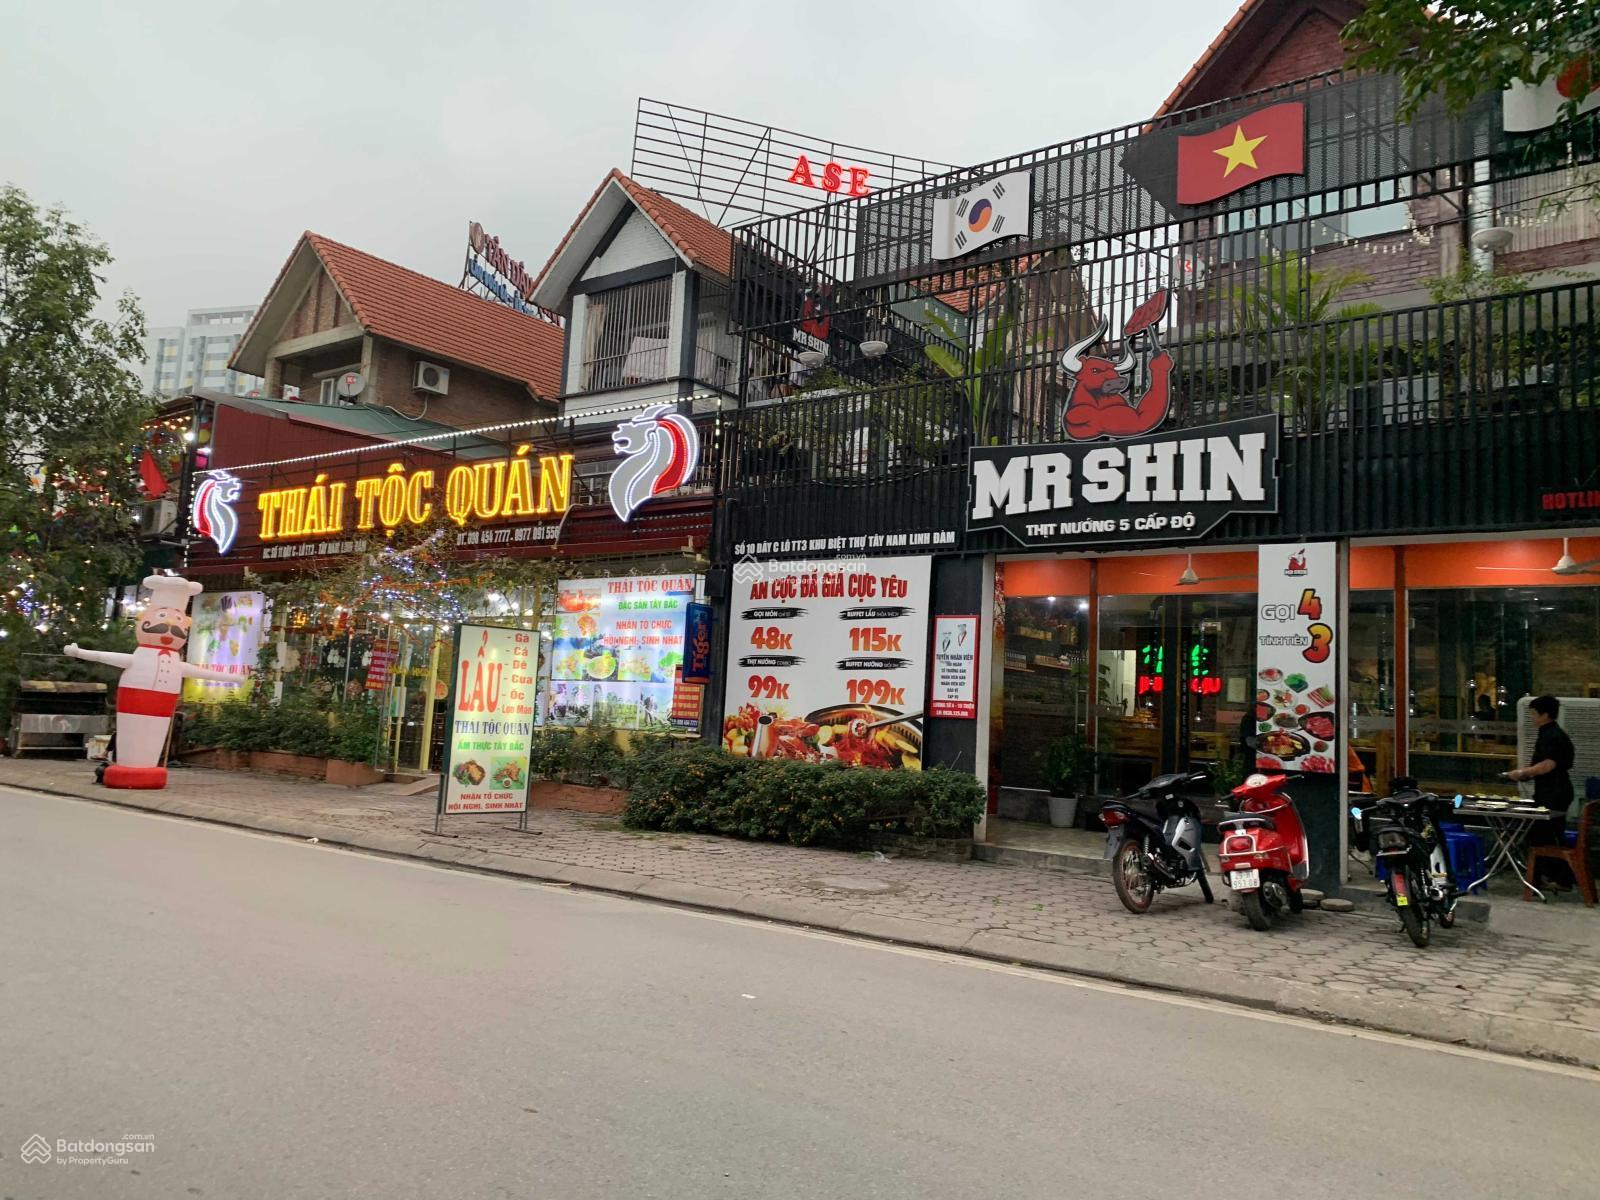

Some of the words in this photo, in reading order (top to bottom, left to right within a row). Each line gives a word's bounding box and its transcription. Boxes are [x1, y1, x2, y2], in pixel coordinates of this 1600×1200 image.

[787, 155, 869, 197] ASE
[972, 451, 1073, 520] MR
[1081, 432, 1266, 503] SHIN
[258, 473, 346, 539] THÁI
[355, 462, 434, 538] TỘC
[445, 443, 575, 526] QUÁN
[1026, 522, 1056, 538] THỊT
[1060, 516, 1116, 535] NƯỚNG
[1119, 517, 1130, 531] 5
[1134, 514, 1167, 531] CẤP
[1171, 511, 1195, 531] ĐỘ
[773, 541, 779, 553] C
[790, 540, 807, 552] TT3
[809, 538, 826, 551] KHU
[827, 536, 847, 552] BIỆT
[868, 533, 884, 548] TÂY
[886, 534, 906, 546] NAM
[909, 532, 930, 545] LINH
[933, 529, 955, 544] ĐÀM
[848, 572, 876, 602] CỰC
[880, 574, 908, 598] YÊU
[1261, 604, 1296, 624] GỌI
[1297, 588, 1322, 620] 4
[750, 626, 793, 649] 48K
[848, 627, 902, 651] 115K
[1259, 635, 1283, 646] TÍNH
[1302, 623, 1333, 664] 3
[458, 629, 503, 713] LẨU
[511, 674, 533, 684] Cua
[748, 674, 790, 699] 99K
[846, 678, 905, 705] 199K
